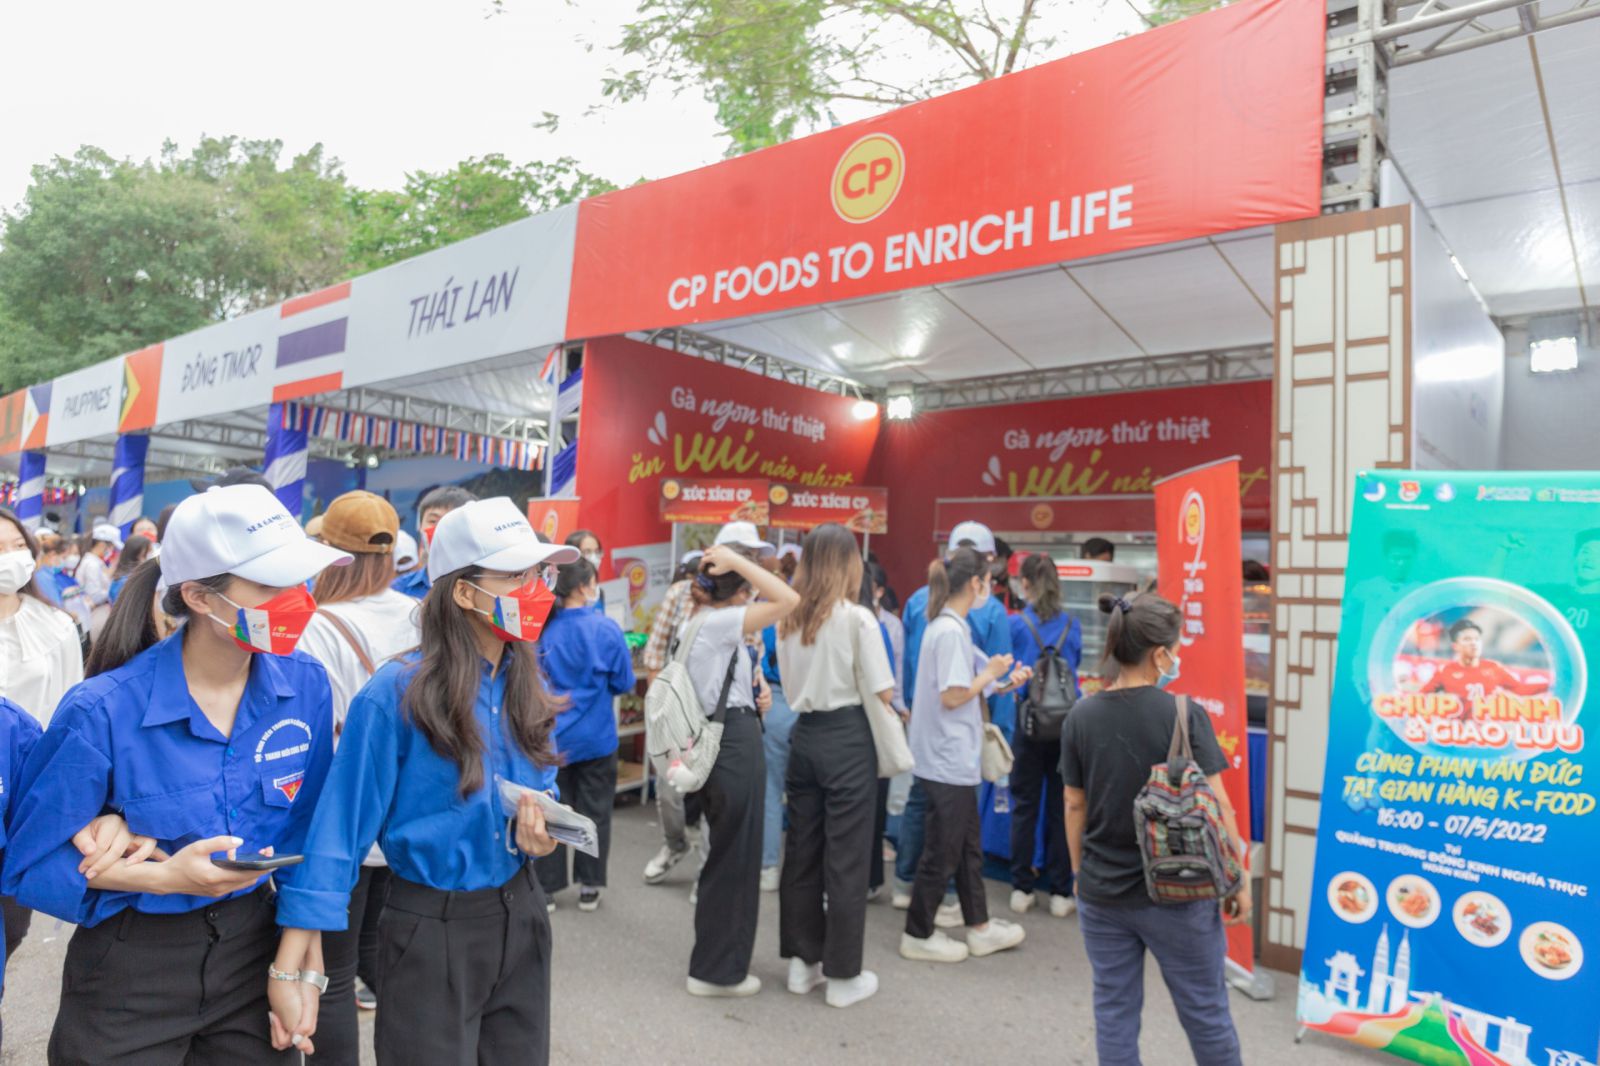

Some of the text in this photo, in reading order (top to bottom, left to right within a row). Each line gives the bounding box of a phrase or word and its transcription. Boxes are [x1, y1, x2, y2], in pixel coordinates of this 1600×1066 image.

[841, 156, 893, 199] CP
[668, 184, 1134, 311] CP FOODS TO ENRICH LIFE
[408, 265, 519, 340] THÁI LAN
[671, 385, 696, 411] Gà
[700, 398, 761, 433] ngon
[762, 407, 790, 432] thứ
[1004, 426, 1030, 450] Gà
[1035, 425, 1108, 462] ngon
[1112, 419, 1154, 444] thứ
[1374, 693, 1461, 724] CHỤP
[1471, 688, 1562, 723] HÌNH
[1404, 717, 1427, 742] &
[1430, 717, 1509, 747] GIAO
[1355, 748, 1583, 786] CÙNG PHAN VĂN ĐỨC
[1342, 775, 1377, 798] TẠI
[1379, 780, 1433, 803] GIAN
[1436, 779, 1499, 810] HÀNG
[1376, 807, 1424, 830] 16:00
[1444, 815, 1547, 844] 07/5/2022
[1467, 859, 1500, 878] KINH
[1501, 867, 1546, 886] NGHĨA
[1547, 877, 1588, 897] THỤC
